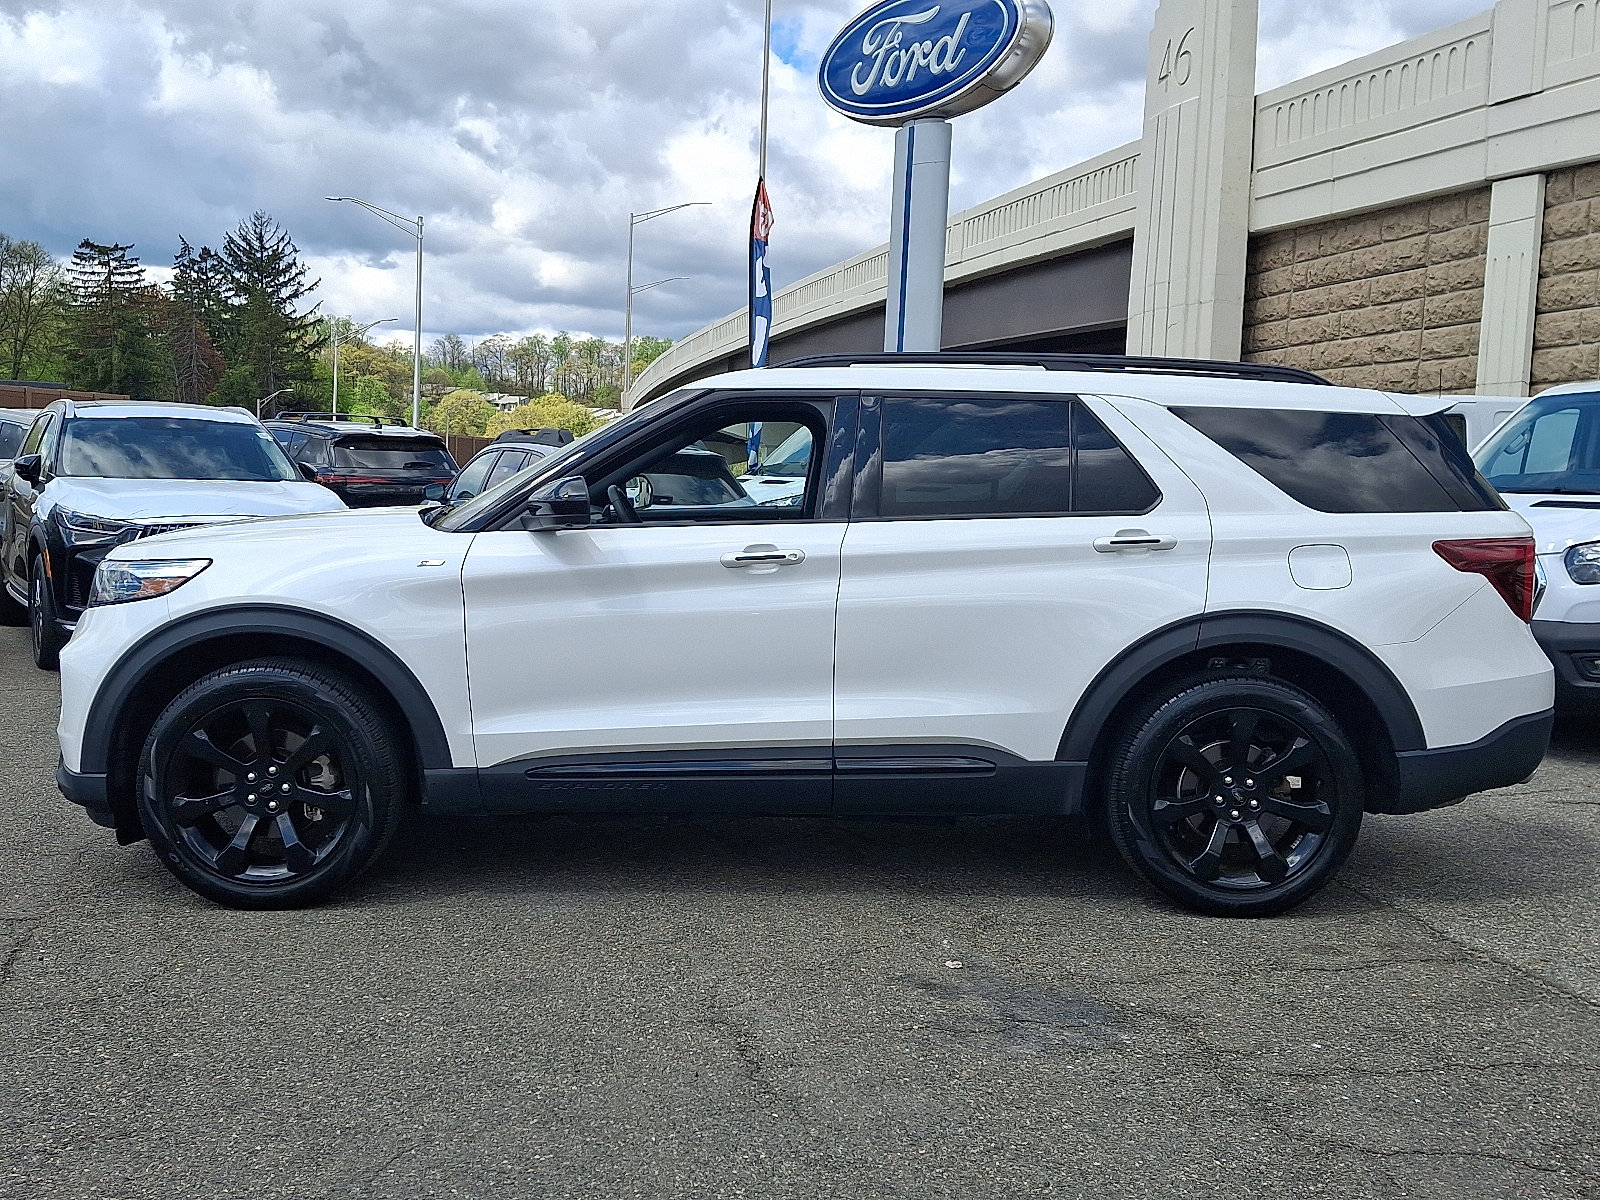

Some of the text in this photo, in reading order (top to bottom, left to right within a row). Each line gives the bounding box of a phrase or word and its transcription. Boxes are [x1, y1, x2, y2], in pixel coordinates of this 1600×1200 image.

[851, 4, 972, 97] Ford
[1158, 27, 1194, 92] 46
[537, 782, 669, 790] EXPLORER
